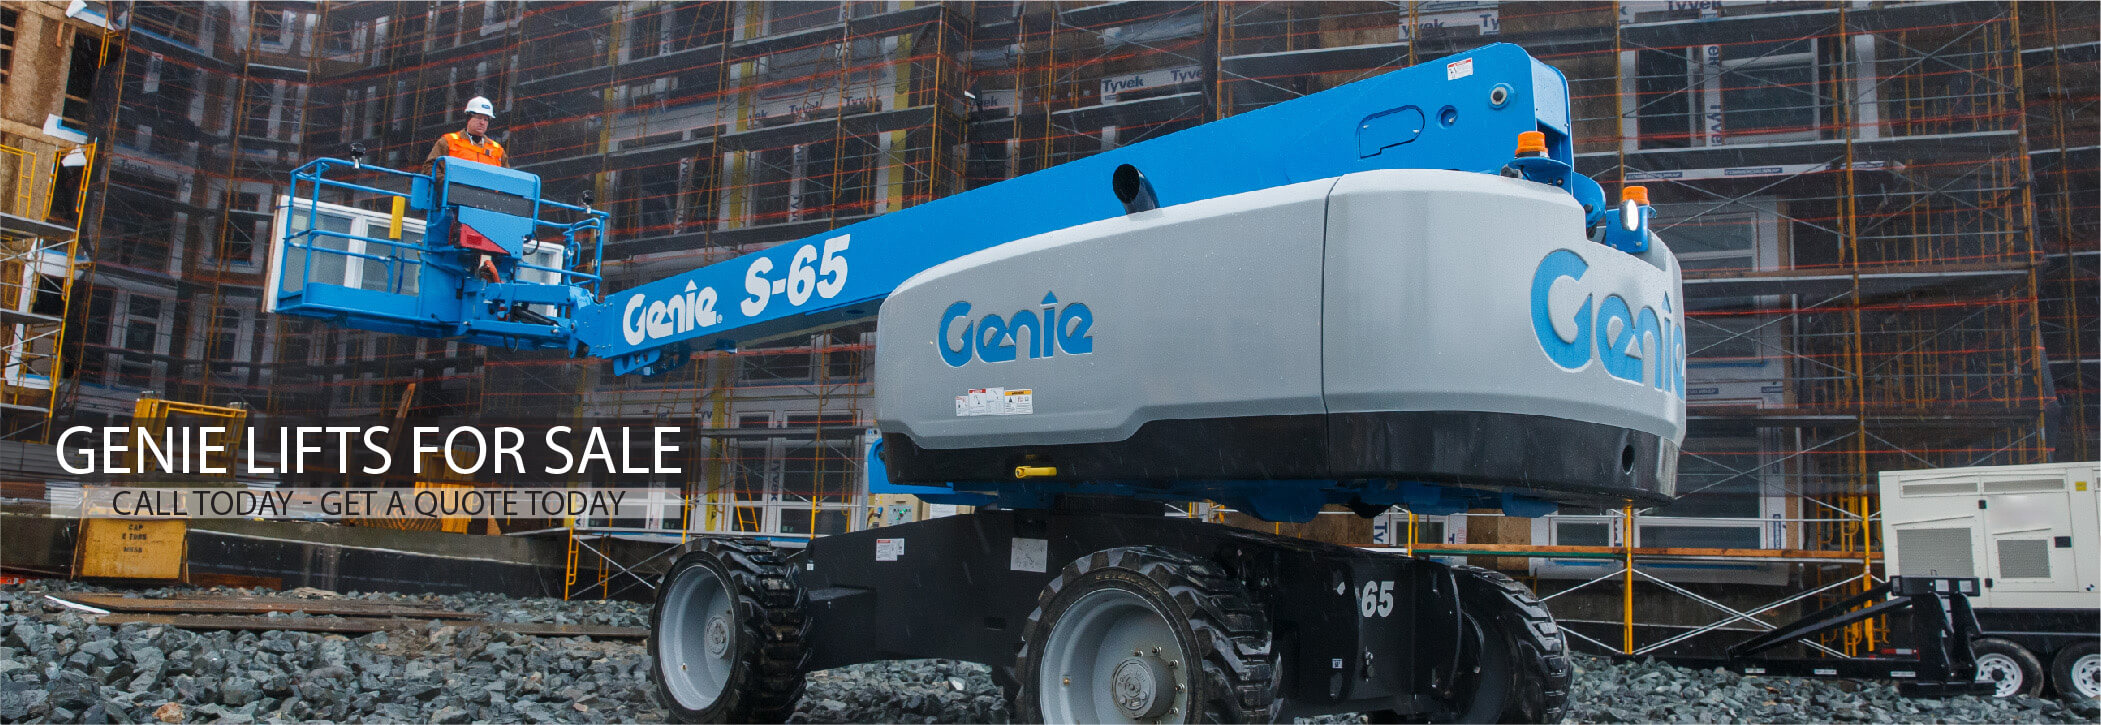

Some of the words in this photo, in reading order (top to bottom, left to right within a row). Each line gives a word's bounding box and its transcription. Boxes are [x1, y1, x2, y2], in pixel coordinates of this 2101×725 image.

[1102, 75, 1144, 94] Tyvek
[1170, 67, 1201, 84] Tyve
[622, 279, 719, 346] Genie
[740, 233, 851, 317] S-65
[937, 290, 1094, 368] Genie
[1530, 247, 1686, 402] Genie
[1361, 580, 1395, 618] 65
